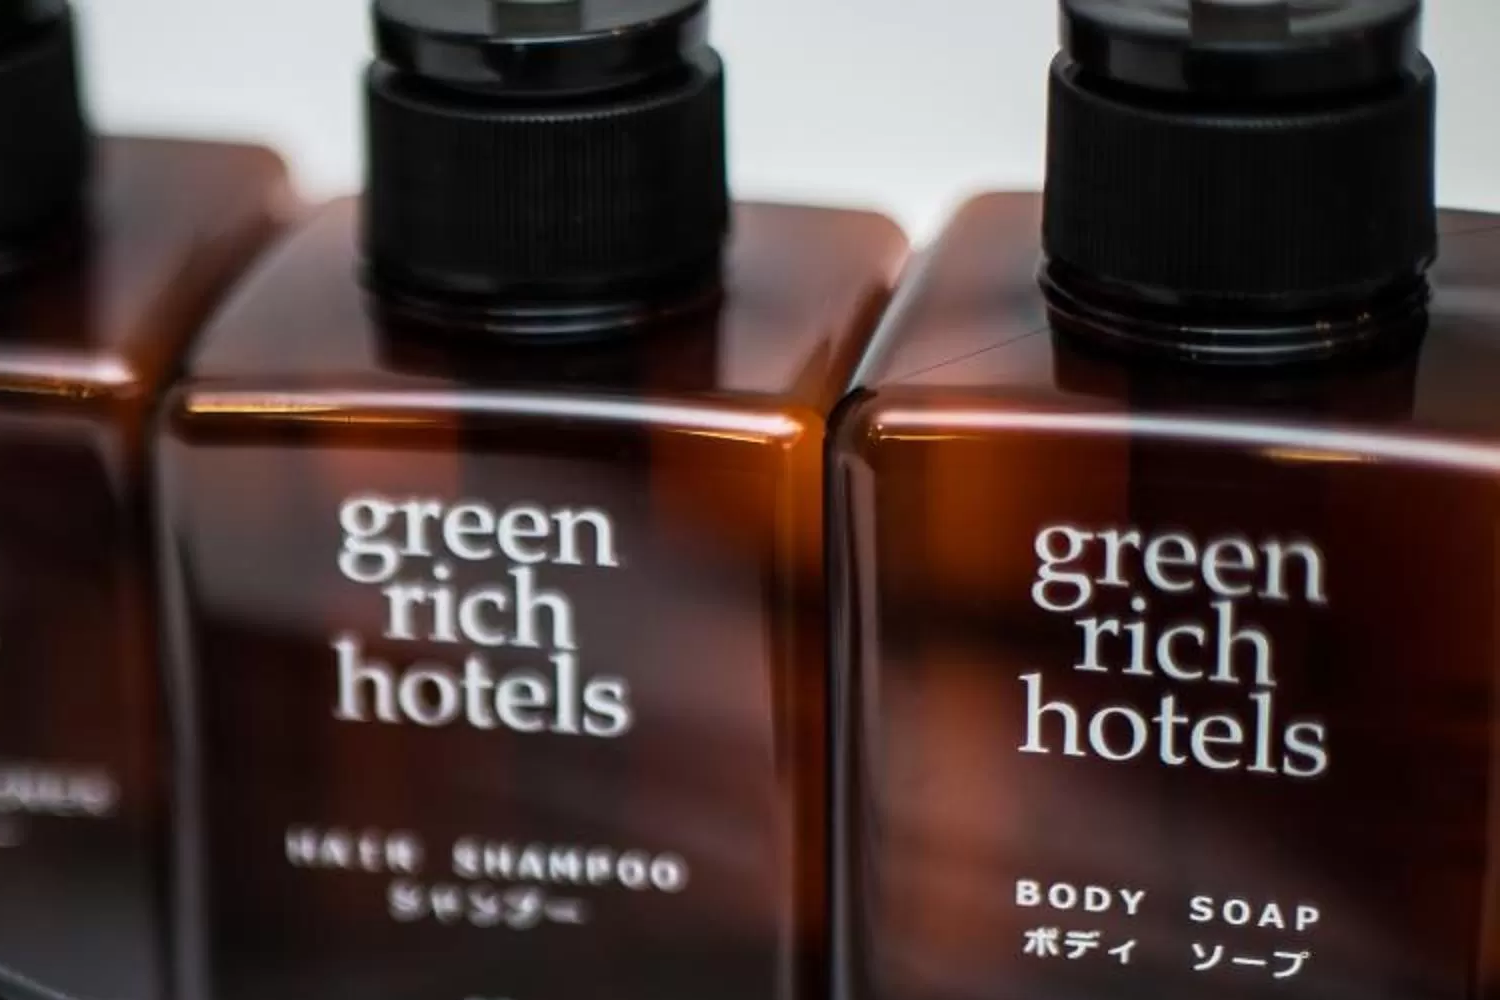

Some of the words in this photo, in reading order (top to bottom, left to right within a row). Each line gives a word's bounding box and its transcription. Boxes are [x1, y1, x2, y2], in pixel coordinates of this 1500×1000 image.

[337, 494, 620, 584] green
[1030, 521, 1328, 612] green
[382, 563, 577, 650] rich
[1073, 596, 1278, 688] rich
[332, 633, 633, 738] hotels
[1016, 671, 1331, 777] hotels
[284, 826, 423, 876] HAIR
[450, 836, 688, 894] SHAMPOO
[1014, 878, 1145, 916] BODY
[1188, 895, 1321, 932] SOAP
[1022, 926, 1137, 965] ボディ
[1190, 942, 1311, 979] ソープ
